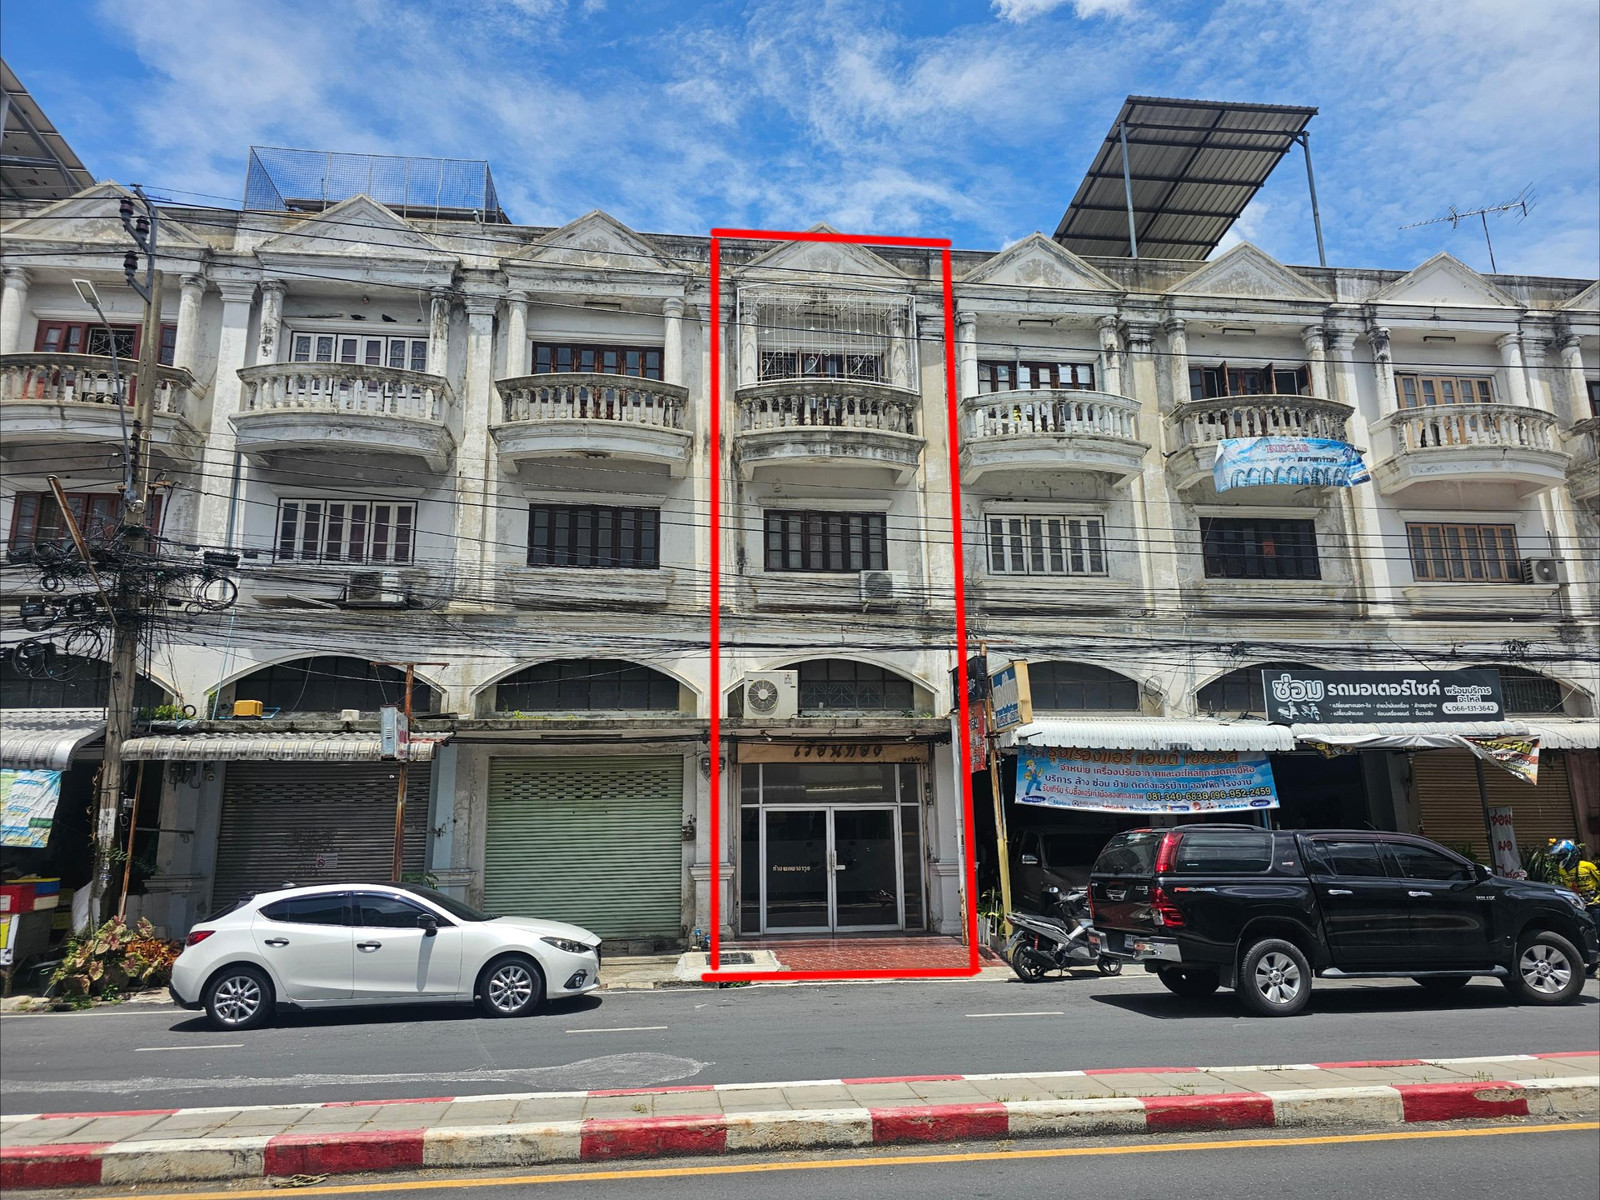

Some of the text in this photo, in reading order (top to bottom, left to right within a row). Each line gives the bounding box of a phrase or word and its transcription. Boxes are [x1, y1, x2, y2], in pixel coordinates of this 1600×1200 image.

[1272, 674, 1441, 701] ซ่อม รถมอเตอร์ไซค์
[1444, 685, 1492, 696] พร้อมบริการ
[1452, 704, 1495, 712] 066-131-3642
[1045, 774, 1072, 785] บริการ
[1075, 777, 1090, 786] ล้าง
[1092, 777, 1110, 788] ซ่อม
[1113, 779, 1129, 788] ย้าย
[1220, 778, 1252, 788] โรงงาน
